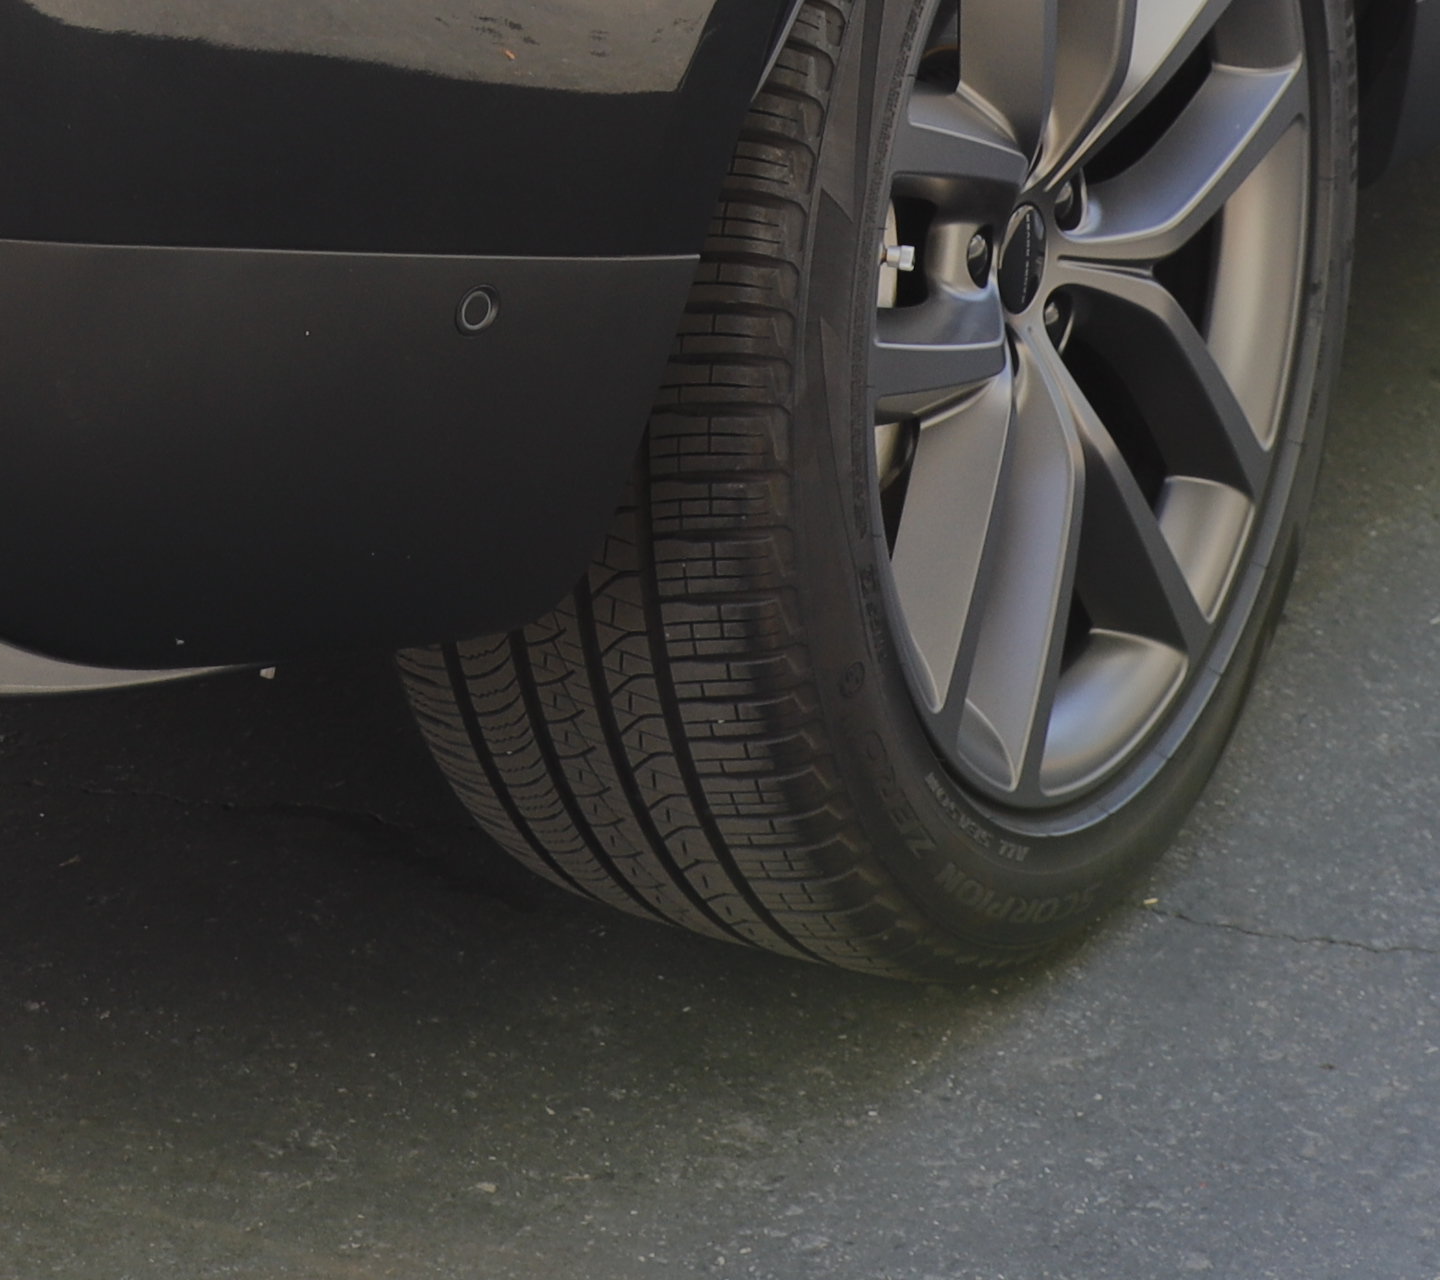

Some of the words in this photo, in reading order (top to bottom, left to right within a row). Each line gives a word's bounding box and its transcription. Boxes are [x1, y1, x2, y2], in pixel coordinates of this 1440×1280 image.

[865, 728, 938, 860] ZERO
[924, 771, 996, 849] SEASON
[997, 838, 1031, 863] ALL
[933, 861, 1100, 925] SCORPION
